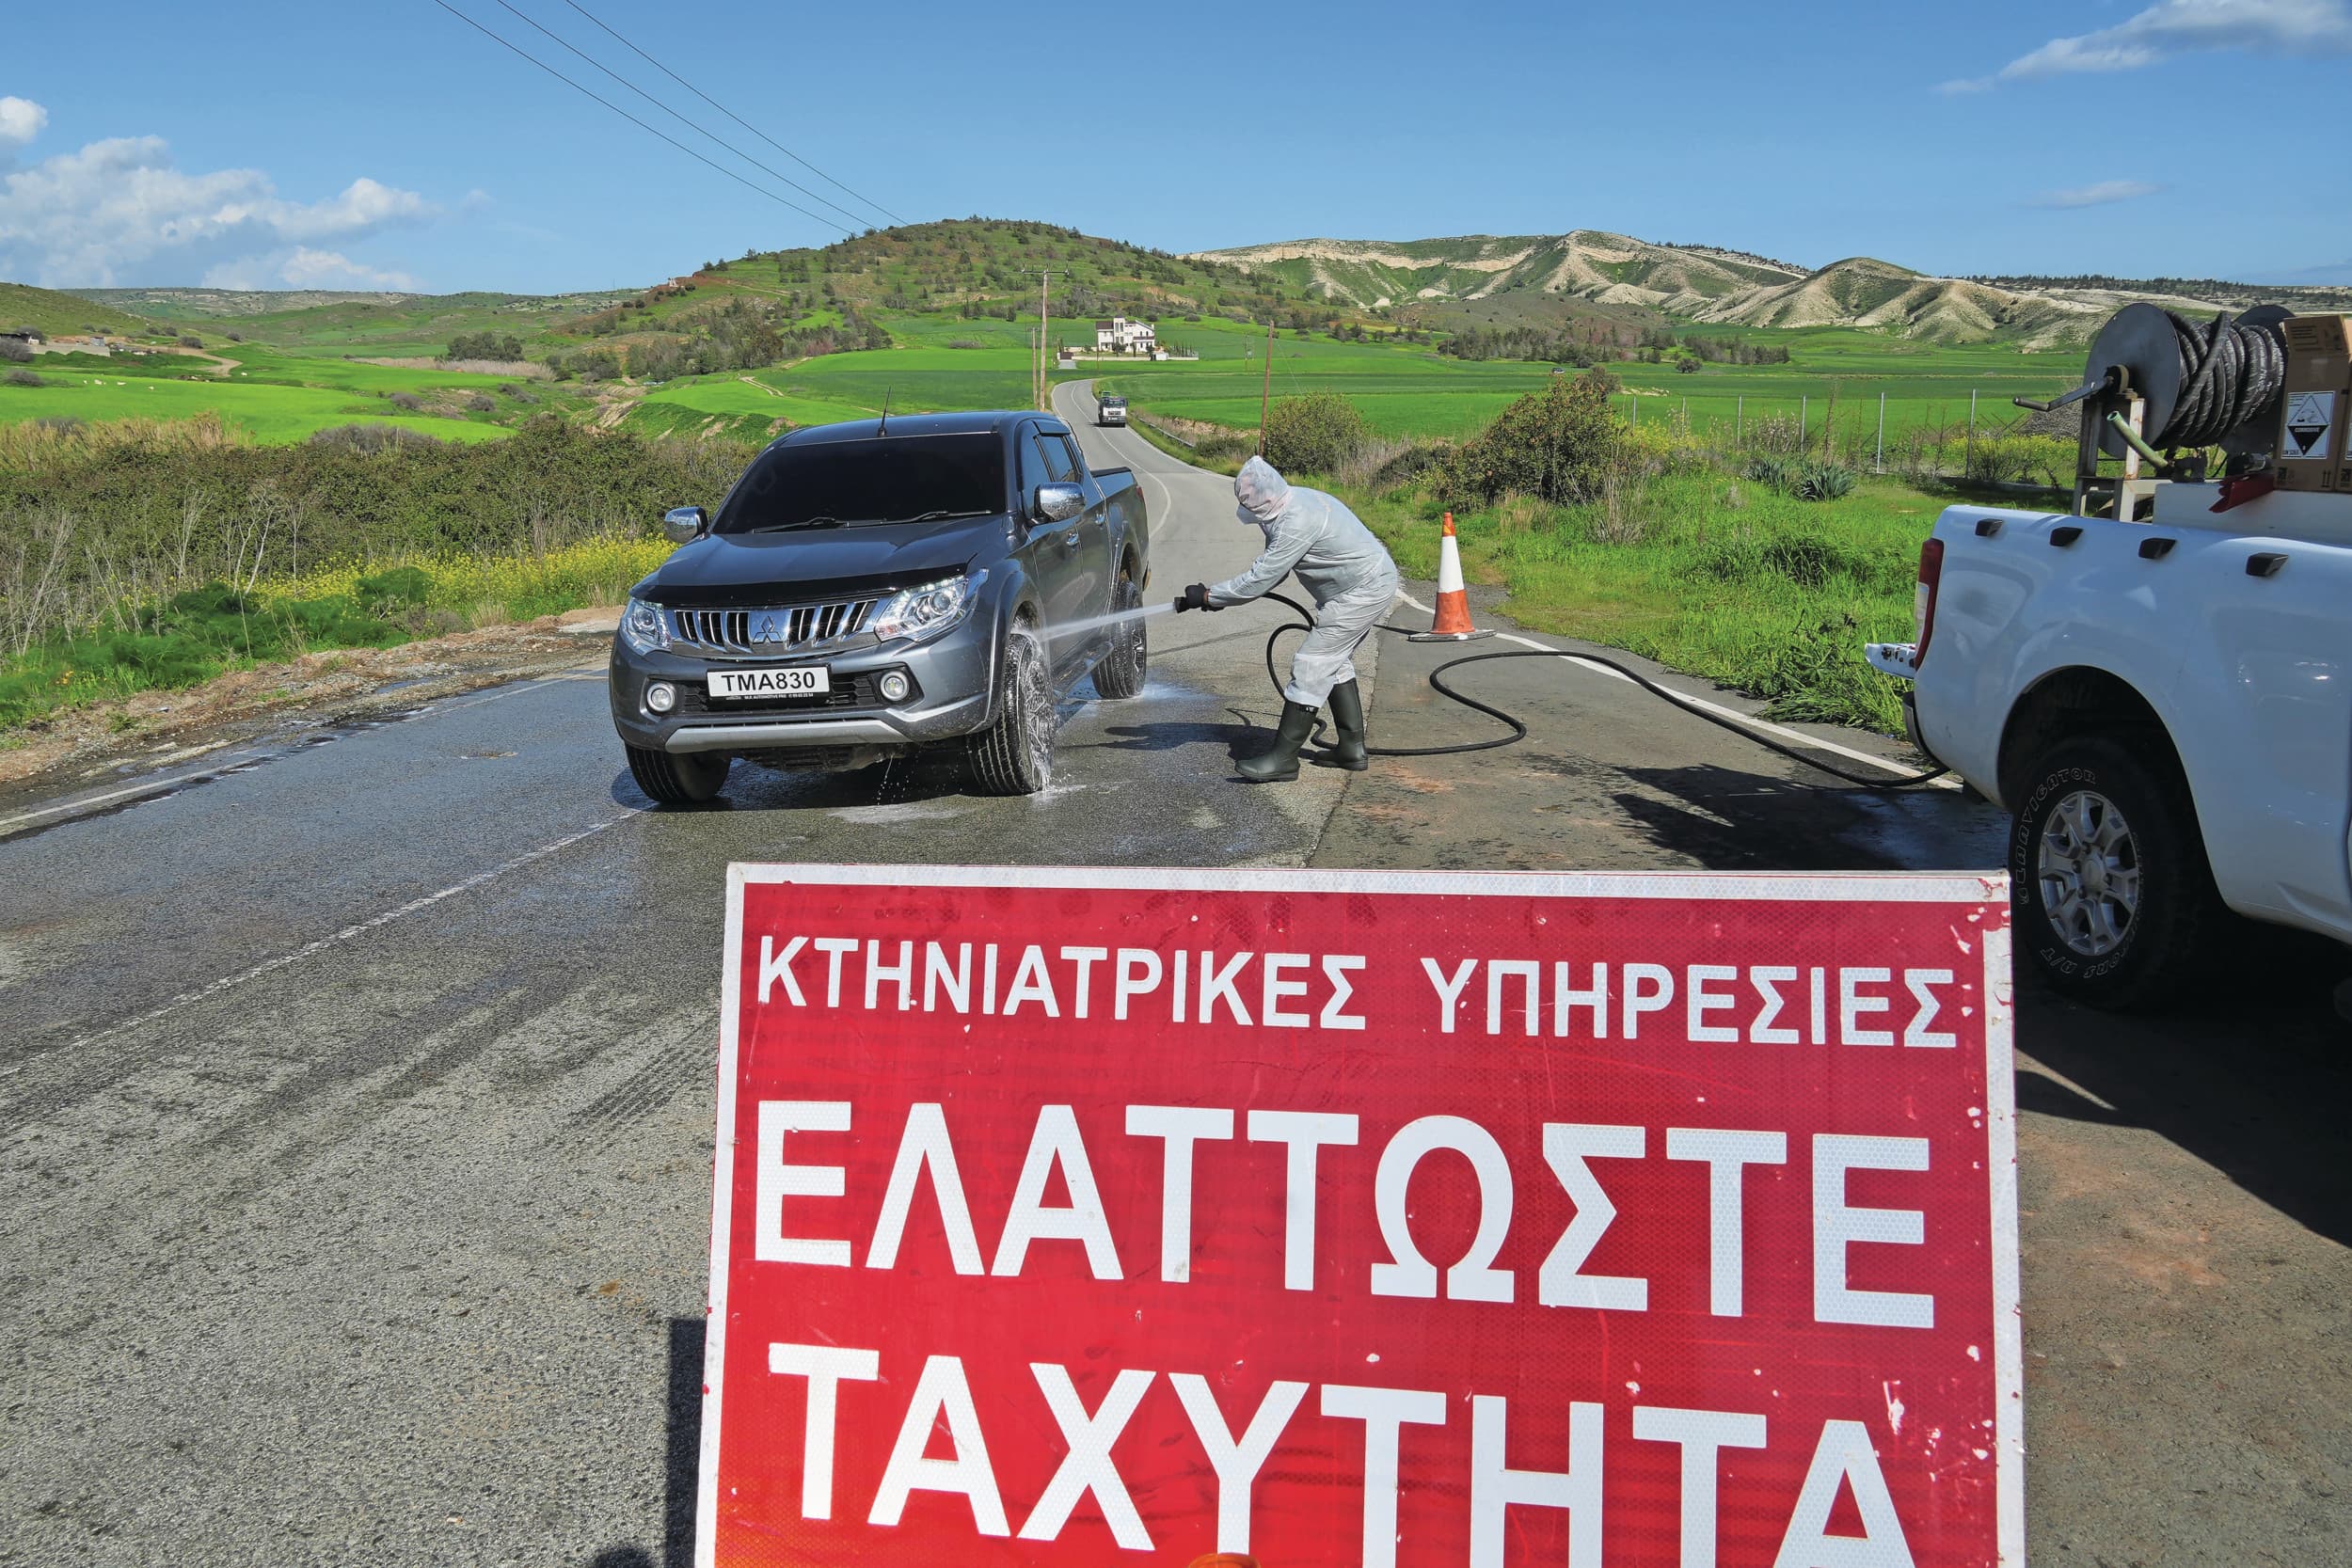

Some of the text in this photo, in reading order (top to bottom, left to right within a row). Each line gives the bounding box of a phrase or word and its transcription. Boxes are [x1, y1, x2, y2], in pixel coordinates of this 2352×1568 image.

[721, 672, 815, 691] TMA830
[757, 935, 1958, 1049] ΚΤΗΝΙΑΤΡΙΚΕΣ ΥΠΗΡΕΣΙΕΣ
[755, 1100, 1935, 1329] ΕΛΑΤΤΩΣΤΕ
[768, 1342, 1917, 1568] ΤΑΧΥΤΗΤΑ
